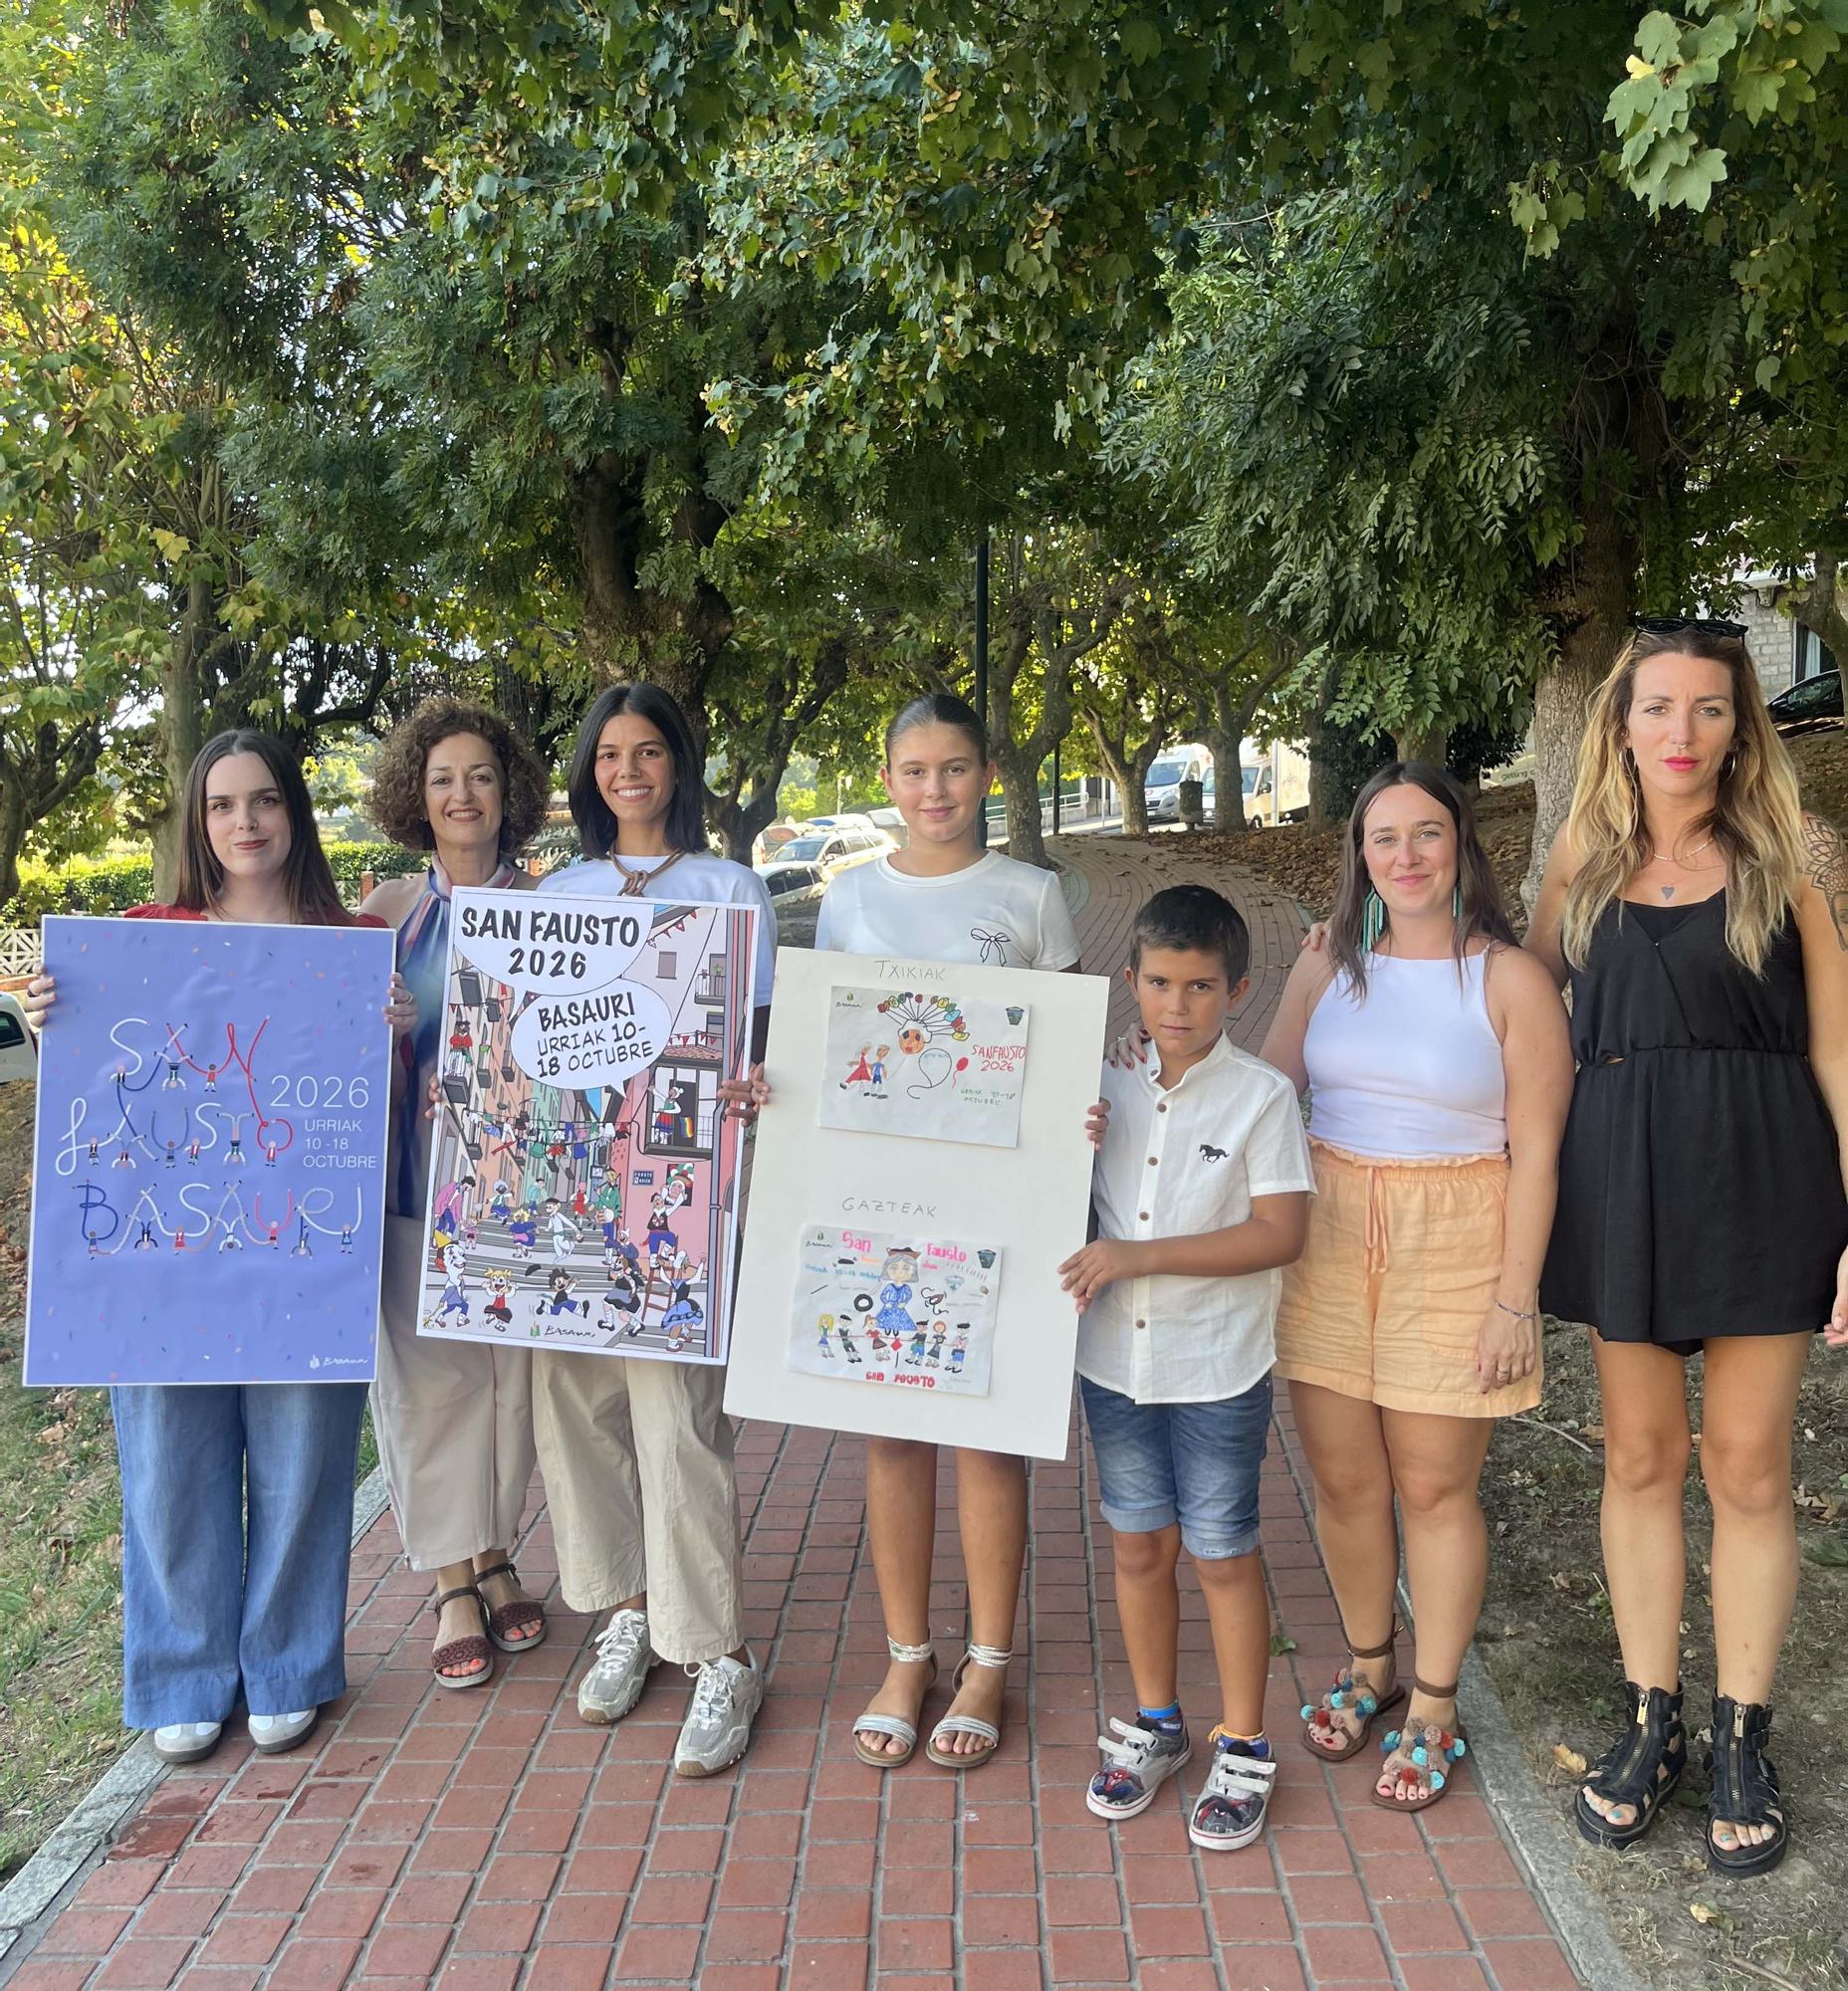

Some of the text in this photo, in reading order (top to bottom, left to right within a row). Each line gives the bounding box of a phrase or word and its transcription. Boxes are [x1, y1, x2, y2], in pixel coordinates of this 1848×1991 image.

[461, 907, 639, 947] SAN FAUSTO
[508, 948, 586, 979] 2026
[874, 960, 947, 981] TXIKIAK
[538, 992, 635, 1031] BASAURI
[110, 1015, 270, 1092] SAN
[537, 1021, 647, 1056] URRIAK 10-
[537, 1040, 654, 1077] 18 OCTUBRE
[981, 1060, 1015, 1072] 2026
[270, 1075, 369, 1109] 2026
[305, 1119, 362, 1132] URRIAK
[303, 1155, 377, 1169] OCTUBRE
[72, 1180, 362, 1258] BASAURI
[841, 1198, 936, 1217] GAZTEAK
[842, 1231, 967, 1262] San Fausto
